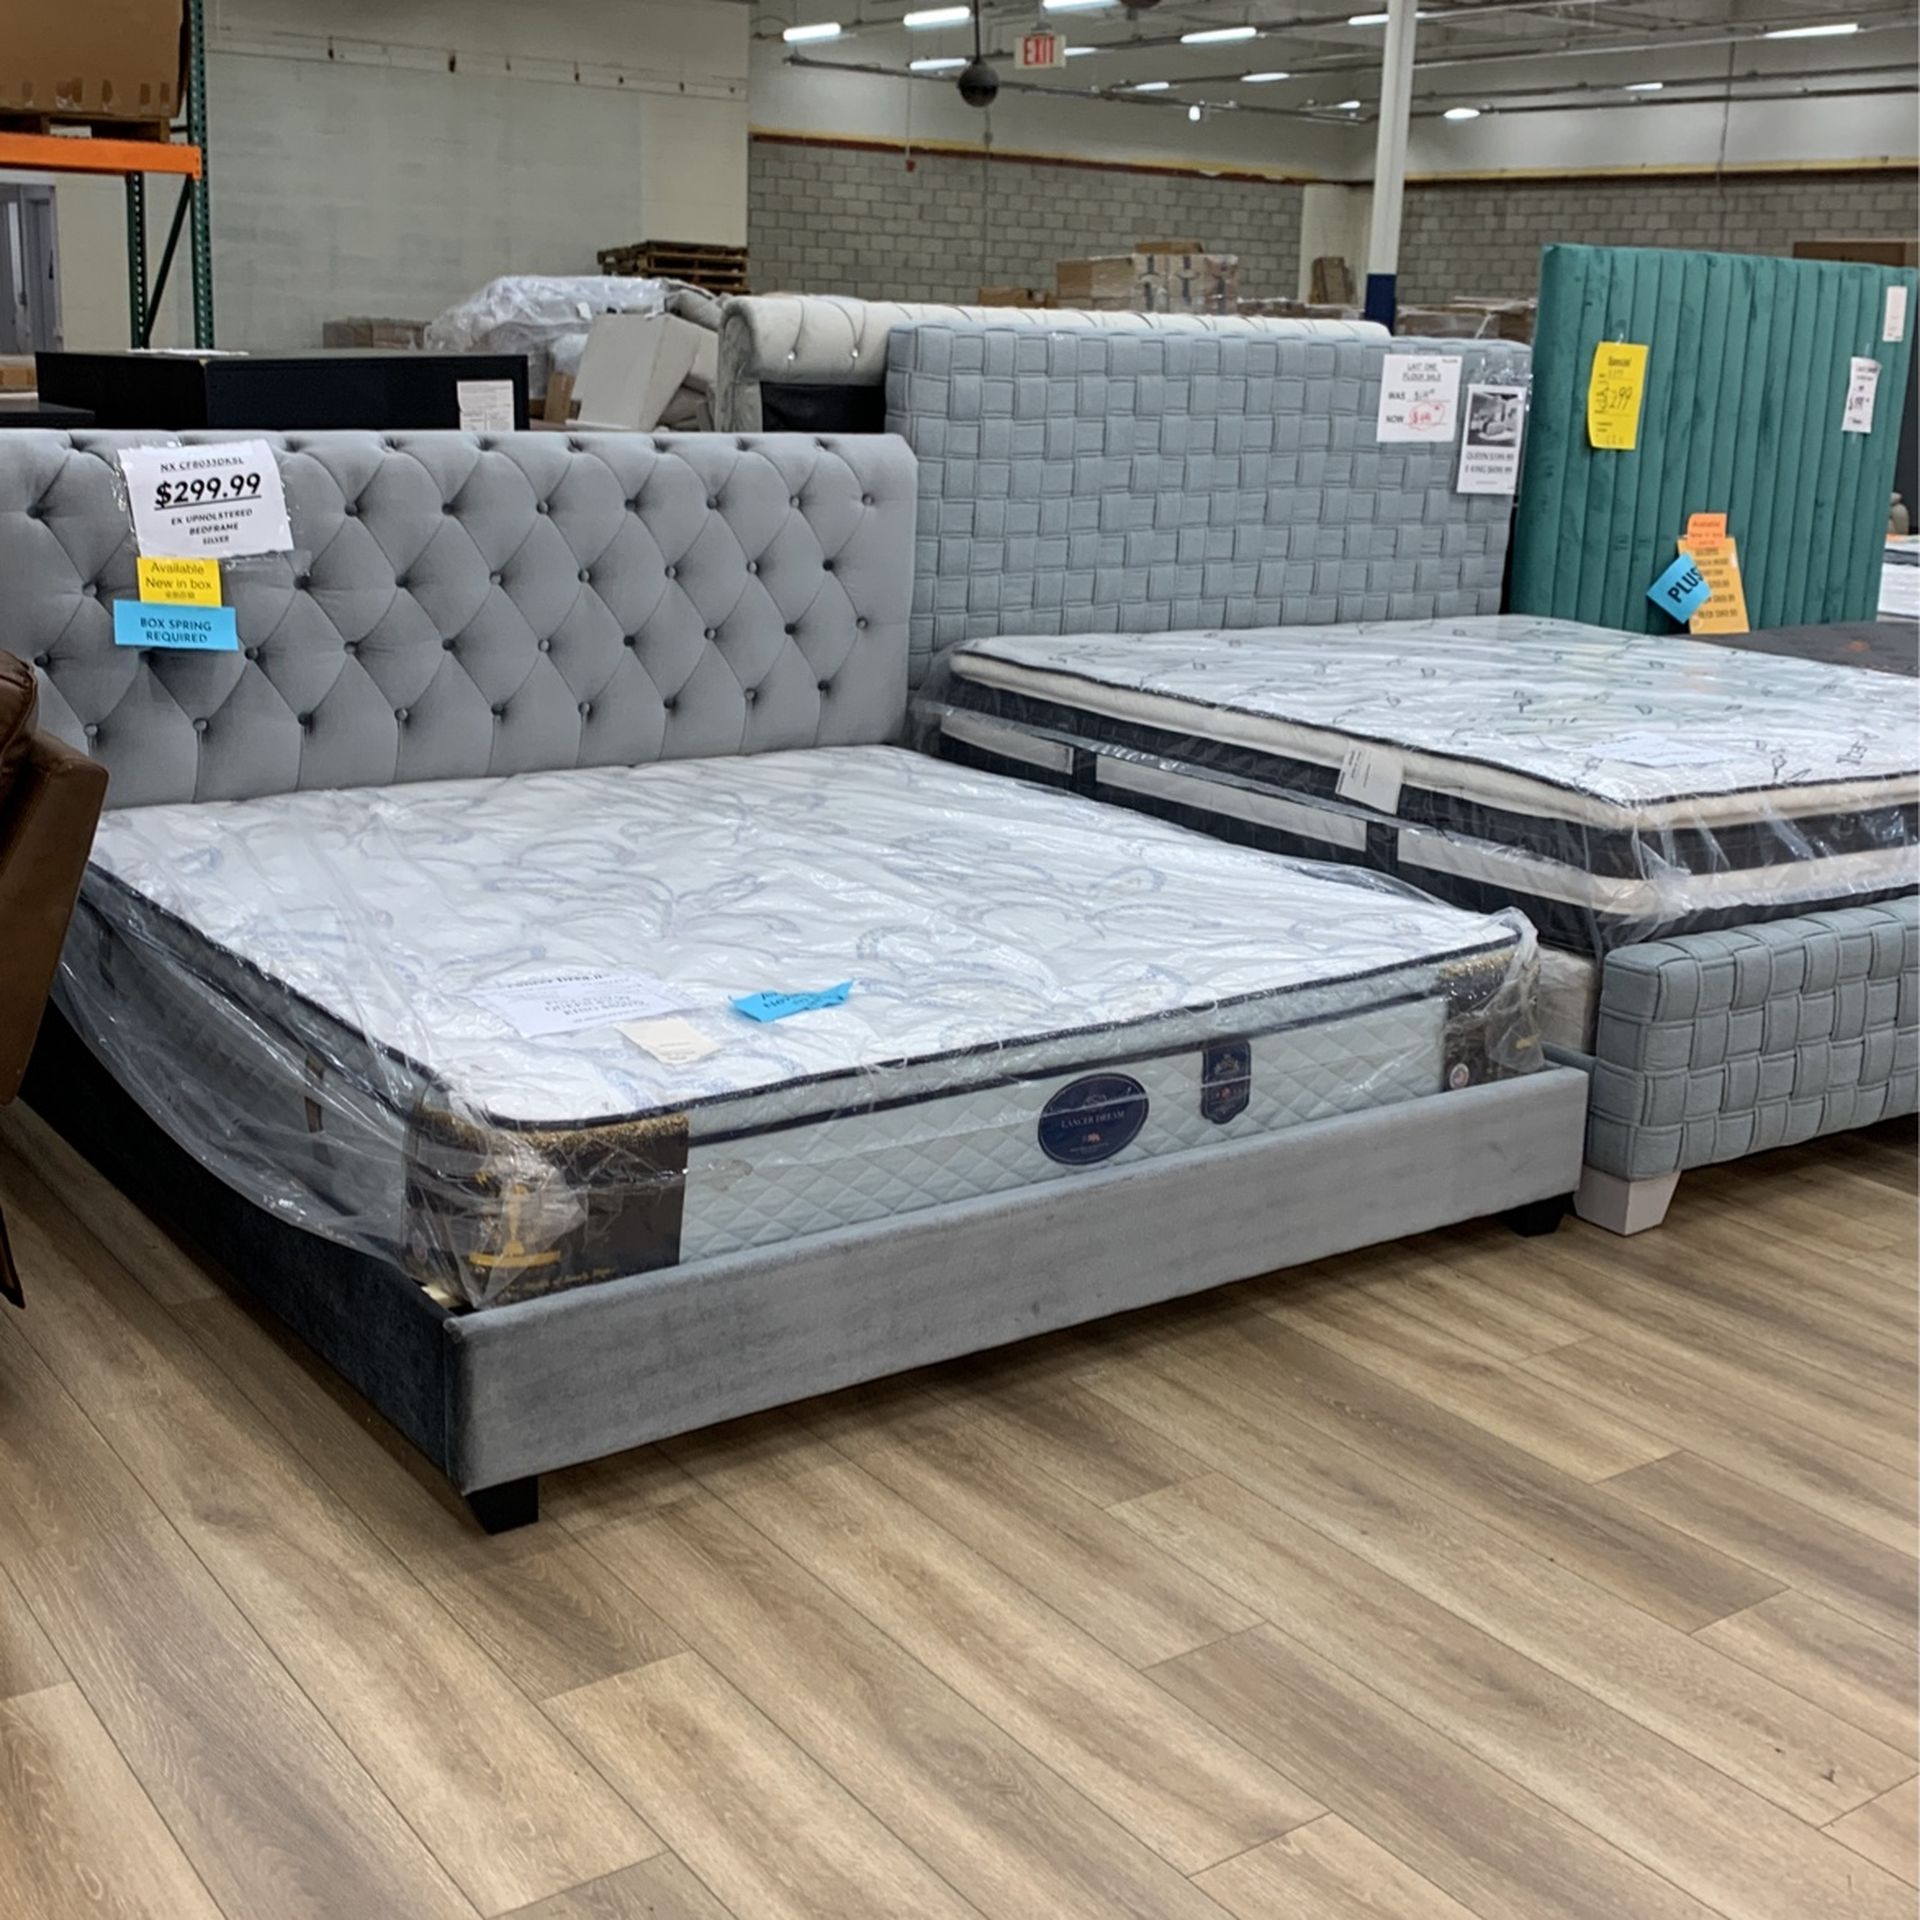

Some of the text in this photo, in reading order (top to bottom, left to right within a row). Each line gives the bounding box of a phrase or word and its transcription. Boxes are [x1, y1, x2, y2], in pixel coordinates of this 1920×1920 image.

[1023, 36, 1055, 66] EXIT
[1388, 392, 1405, 400] WAS
[1386, 415, 1404, 423] NOW
[160, 463, 176, 472] NX
[155, 472, 261, 508] $299.99
[186, 508, 253, 523] UPHOLSTERED
[189, 523, 239, 535] BEDFRAME
[203, 535, 229, 545] SILVER
[151, 562, 204, 575] Available
[145, 577, 212, 590] New in box
[1666, 567, 1703, 604] PLUS
[140, 617, 212, 631] BOX SPRING
[146, 631, 208, 643] REQUIRED
